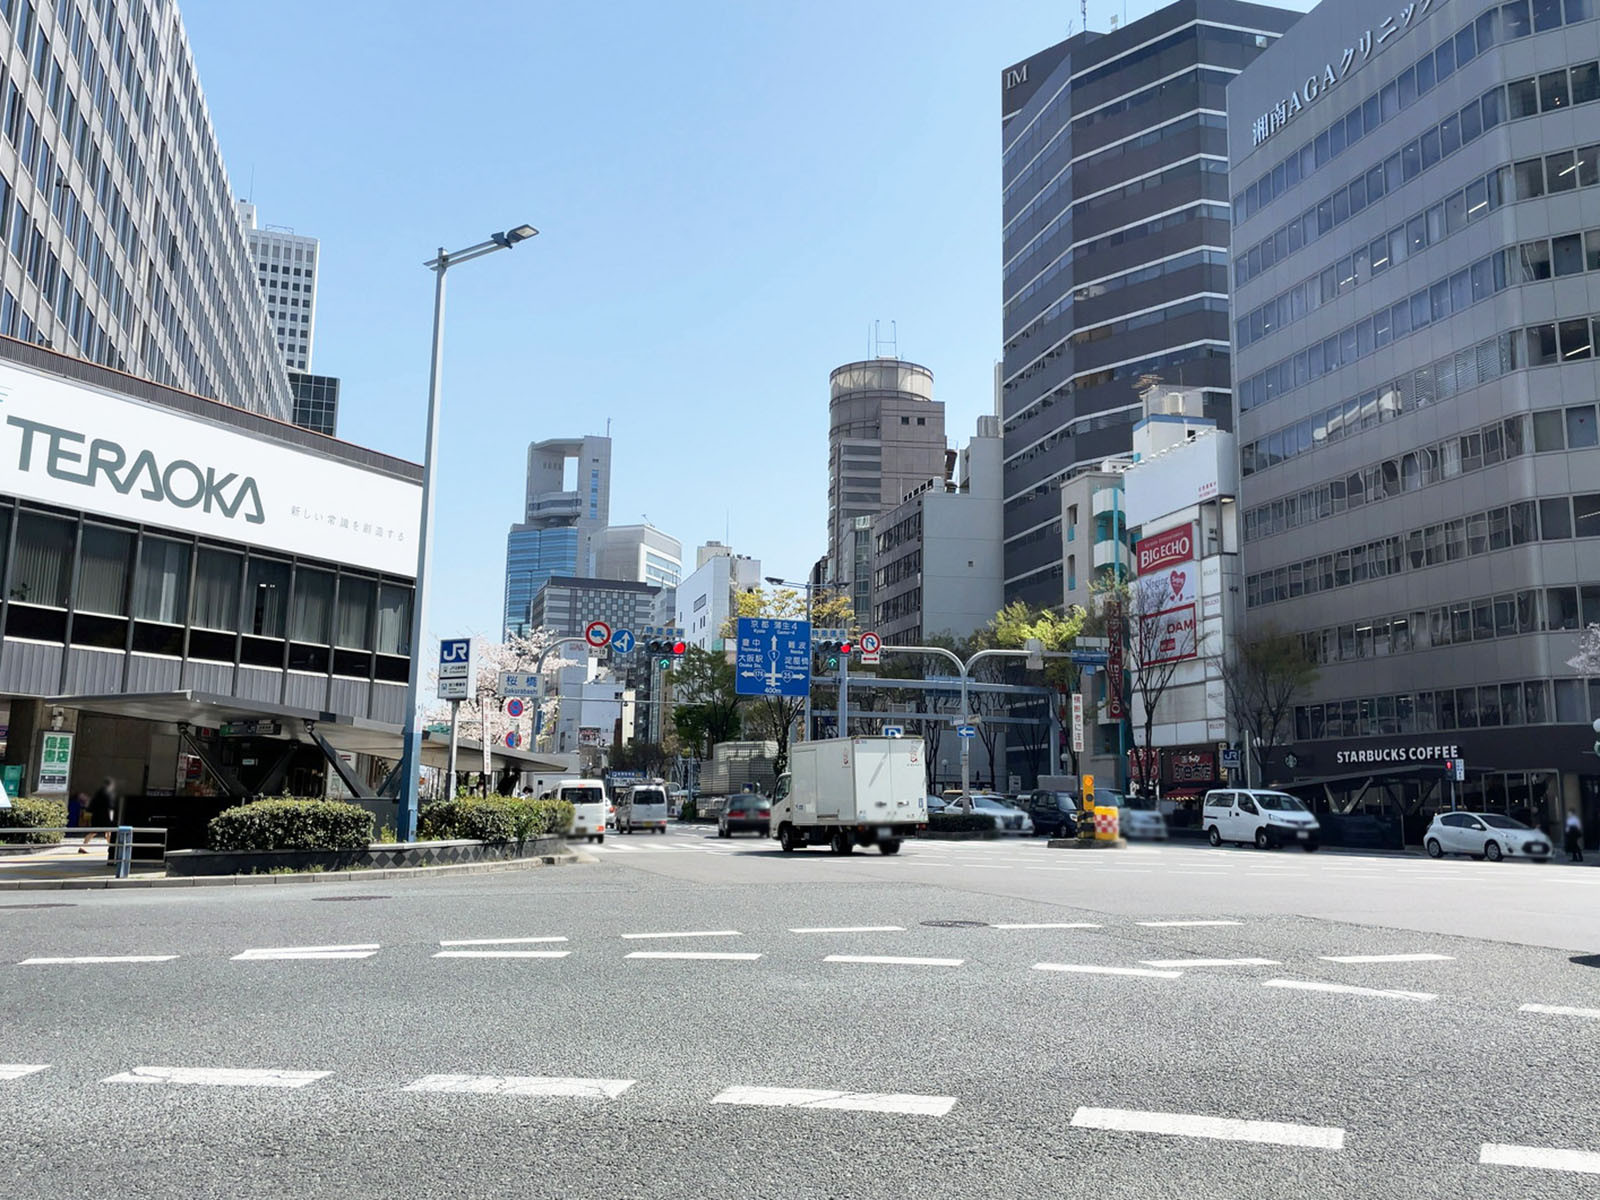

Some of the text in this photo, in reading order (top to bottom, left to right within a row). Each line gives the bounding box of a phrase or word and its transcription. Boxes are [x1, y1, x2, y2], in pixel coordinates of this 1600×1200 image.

[1006, 63, 1029, 90] IM
[7, 415, 265, 525] TERAOKA
[1141, 537, 1190, 568] BIG ECHO
[751, 620, 769, 629] 京都
[1167, 619, 1193, 634] DAM
[443, 642, 468, 661] JR
[738, 654, 764, 664] 大阪駅
[506, 675, 537, 687] 桜橋
[1224, 751, 1238, 760] JR
[1337, 745, 1458, 763] STARBUCKS COFFEE
